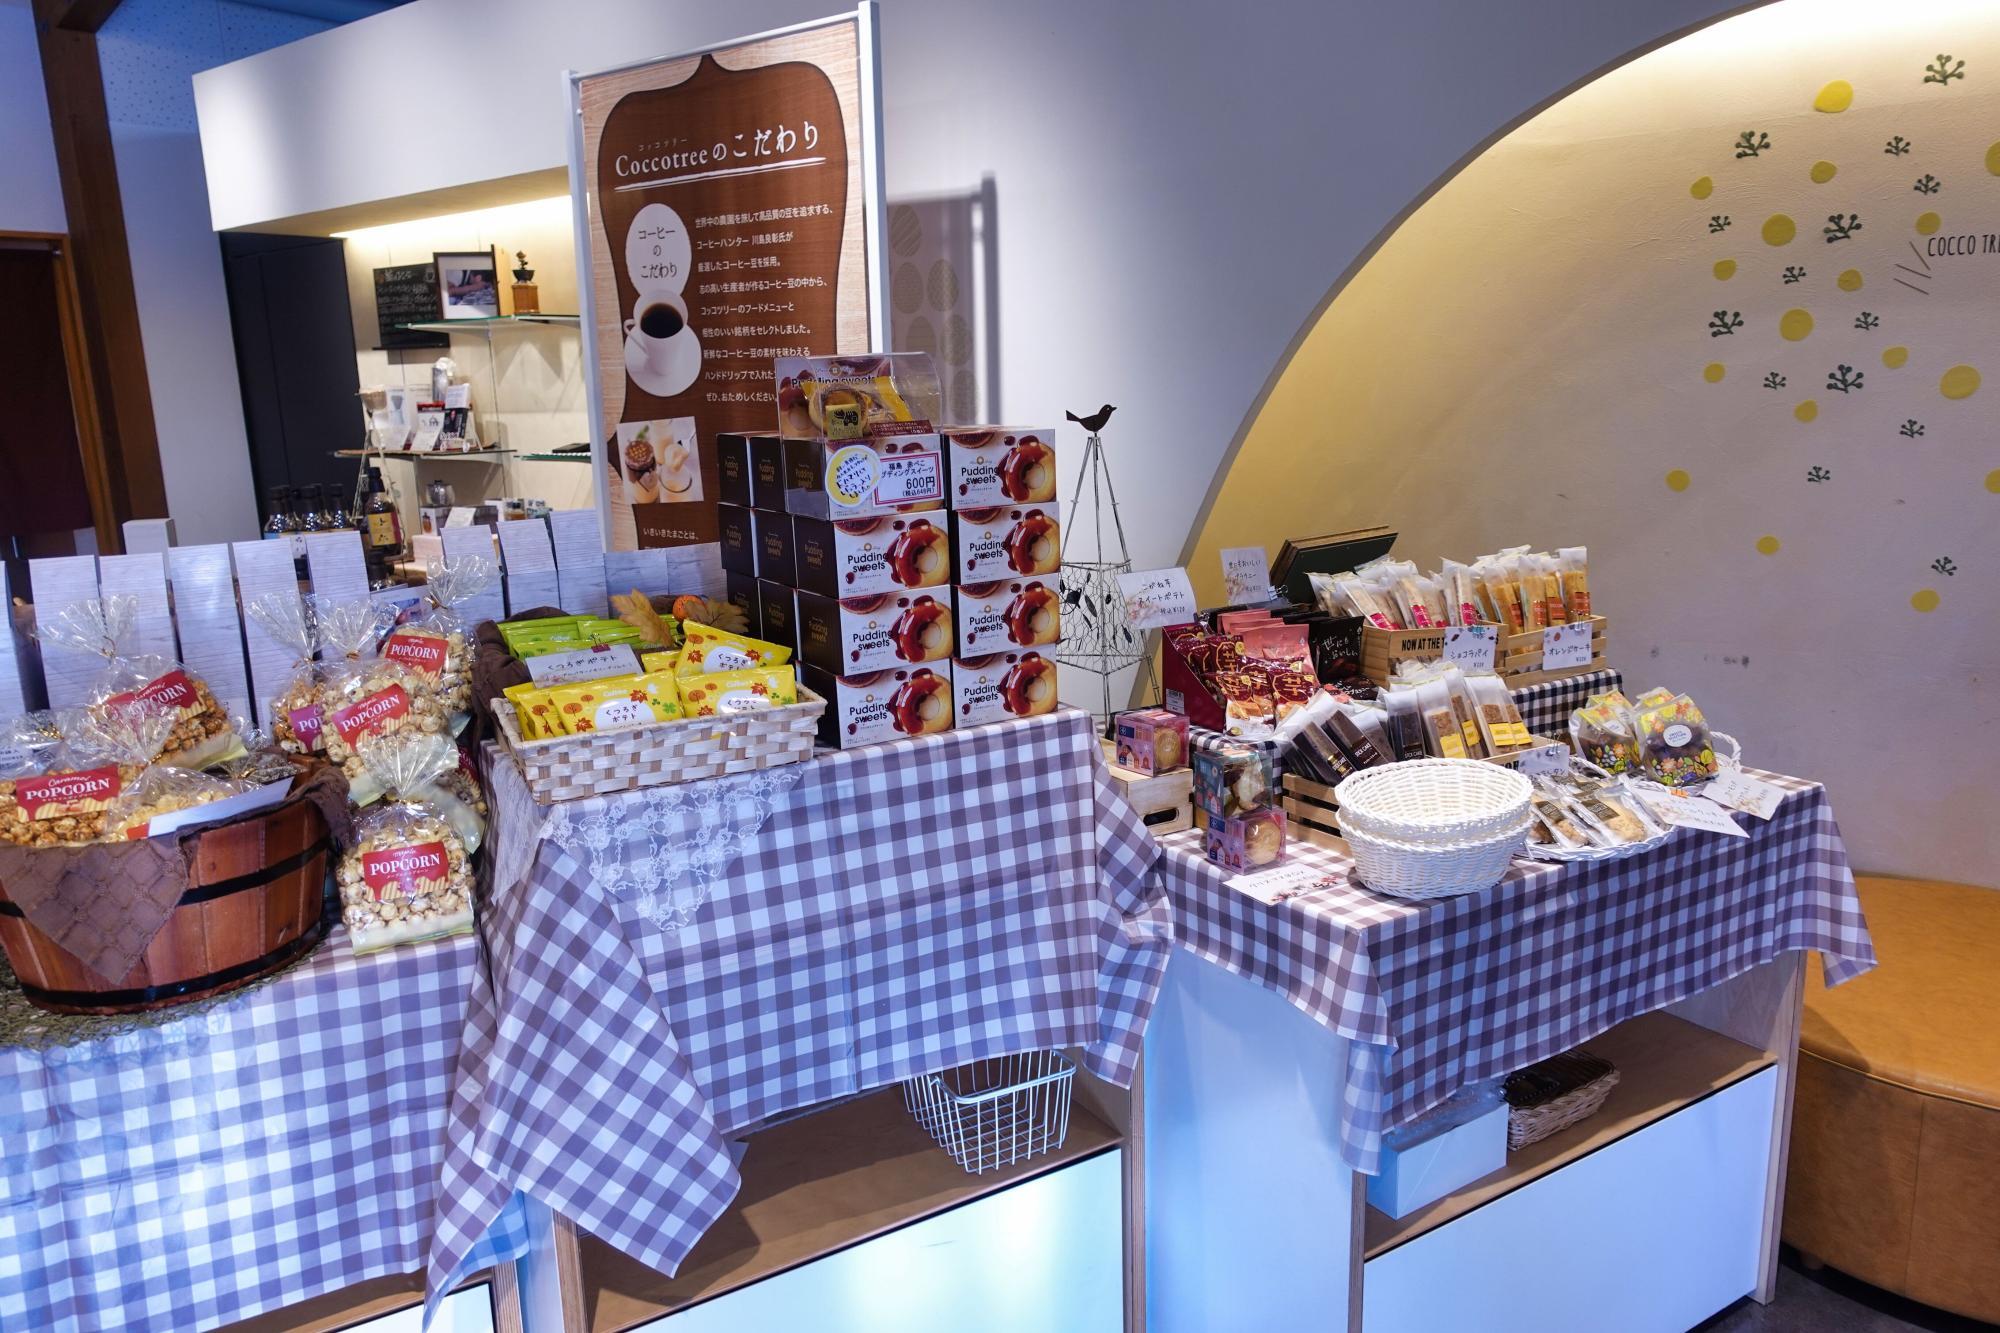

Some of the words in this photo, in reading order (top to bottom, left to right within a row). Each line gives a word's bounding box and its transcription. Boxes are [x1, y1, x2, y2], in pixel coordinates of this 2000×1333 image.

[638, 226, 676, 241] コーヒー
[696, 236, 750, 250] コーヒーハンター
[1927, 235, 1976, 257] COCCO
[652, 244, 662, 257] の
[640, 262, 678, 279] こだわり
[700, 301, 795, 316] コッコツリーのフードメニューと
[704, 370, 776, 382] ハンドドリップで入れた
[961, 465, 999, 477] Pudding
[906, 476, 936, 491] 600円
[965, 474, 997, 486] sweets
[969, 541, 1005, 553] Pudding
[847, 551, 888, 565] Pudding
[974, 549, 1004, 561] sweets
[853, 562, 886, 574] sweets
[1138, 591, 1185, 606] スイートポテト
[969, 613, 1005, 626] Pudding
[973, 622, 1004, 634] sweets
[853, 630, 893, 643] Pudding
[858, 639, 890, 652] sweets
[1401, 638, 1416, 652] NOW
[1418, 638, 1427, 650] AT
[1428, 637, 1441, 650] THE
[1548, 643, 1591, 656] オレンジケーキ
[390, 644, 440, 660] POPCORN
[1449, 648, 1489, 660] ショコラパイ
[964, 684, 1001, 697] Pudding
[968, 692, 999, 705] sweets
[341, 694, 401, 732] POPCORN
[605, 704, 638, 716] くつろぎ
[849, 702, 890, 716] Pudding
[612, 713, 637, 723] ポテト
[854, 711, 888, 724] sweets
[24, 777, 111, 801] POPCORN
[369, 853, 440, 876] POPCORN
